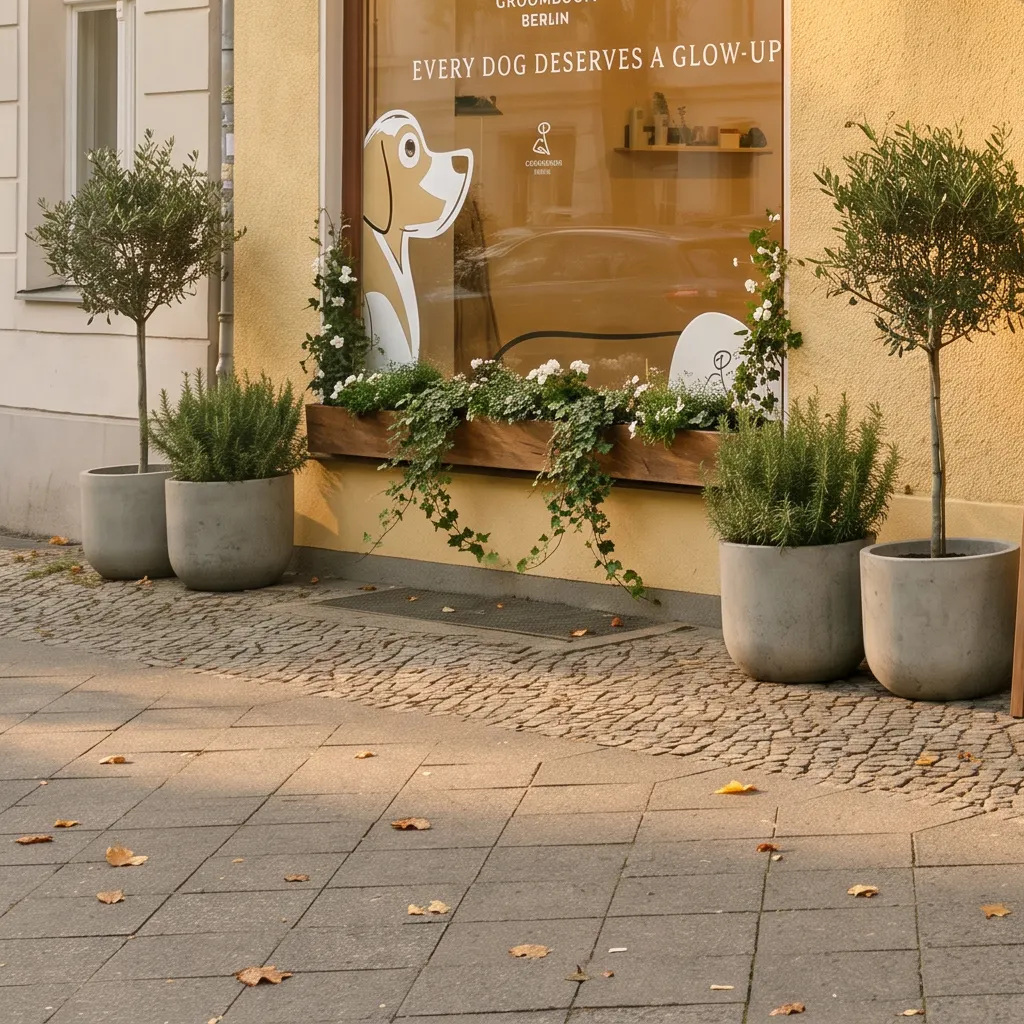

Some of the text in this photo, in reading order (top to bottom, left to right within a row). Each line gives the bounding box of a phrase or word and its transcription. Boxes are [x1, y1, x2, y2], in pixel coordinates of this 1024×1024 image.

[522, 11, 569, 27] BERLIN
[412, 39, 782, 81] EVERY DOG DESERVES A GLOW-UP
